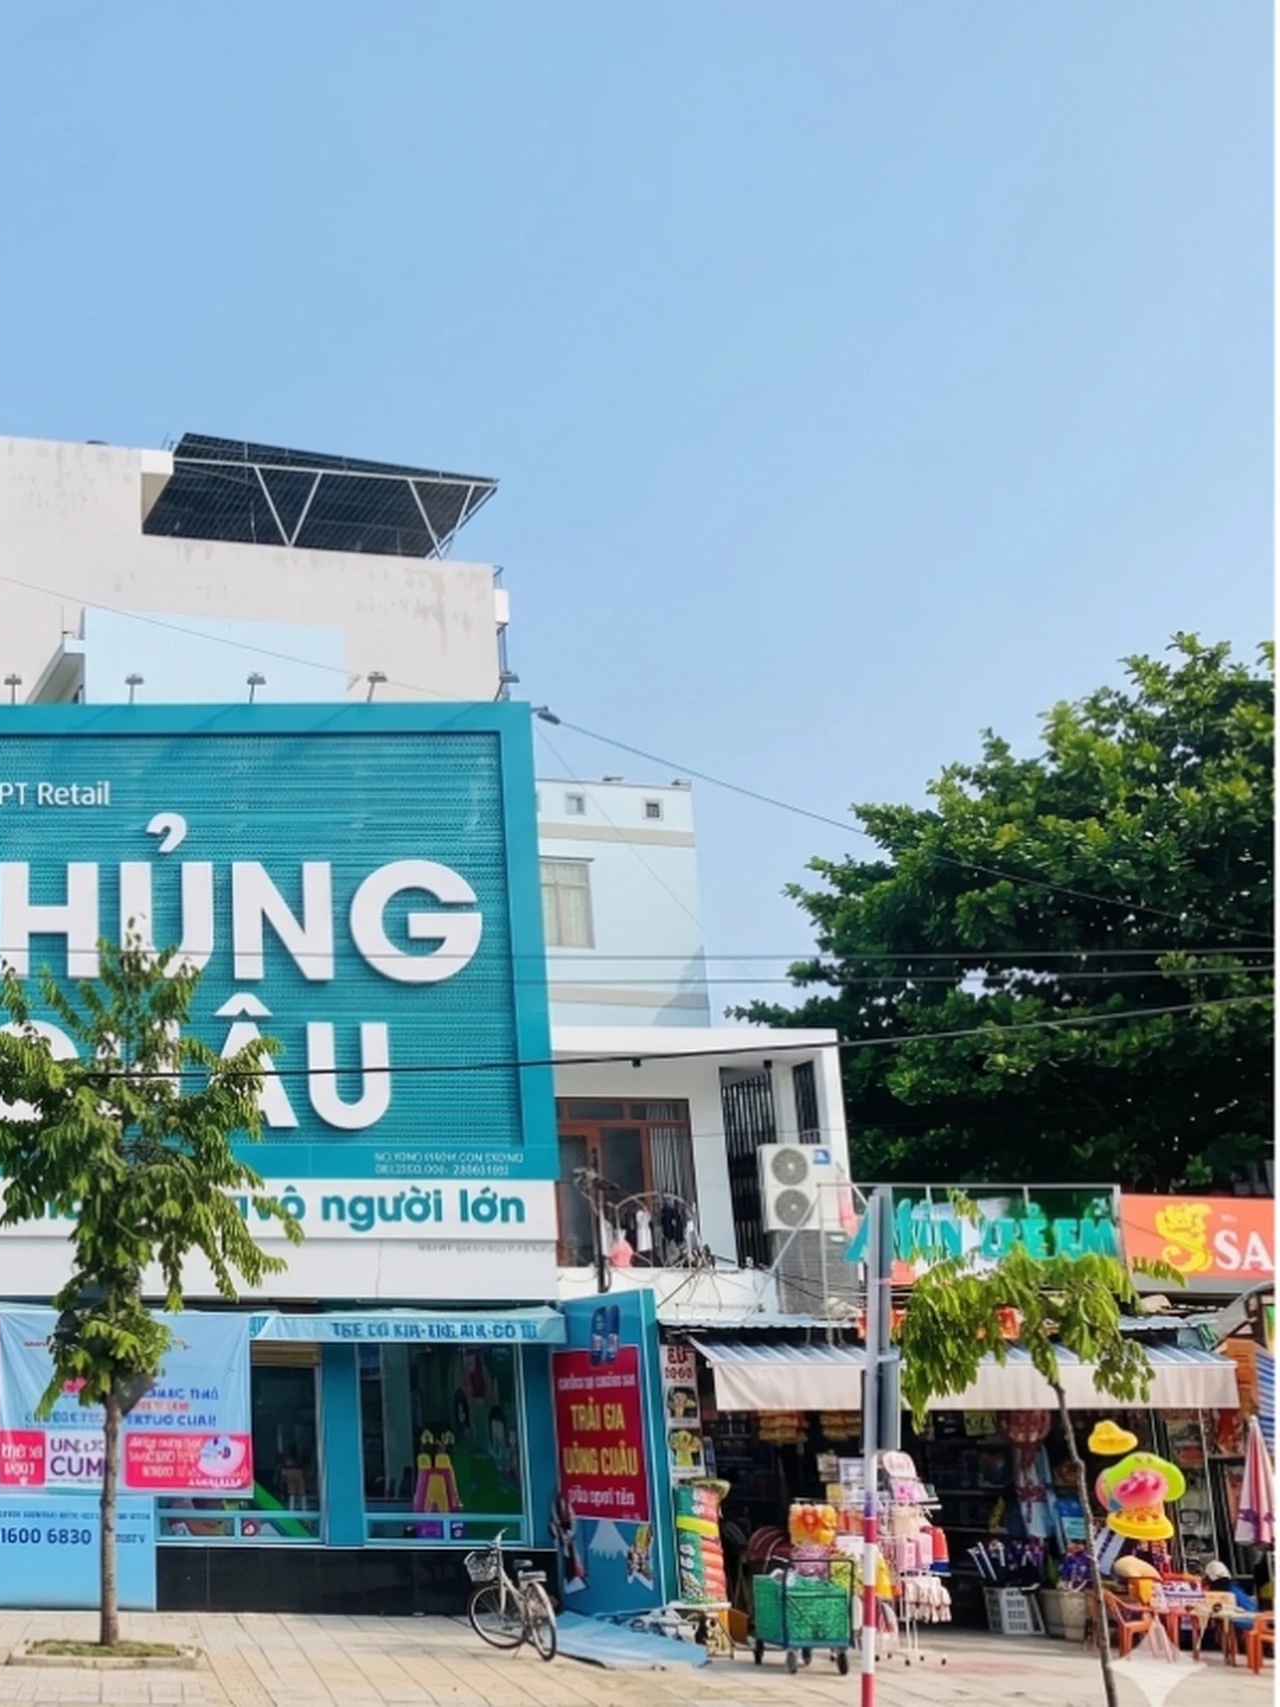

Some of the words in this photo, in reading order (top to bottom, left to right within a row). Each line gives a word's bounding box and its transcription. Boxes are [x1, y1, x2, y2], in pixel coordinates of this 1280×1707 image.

[37, 780, 111, 806] Retail
[321, 1184, 443, 1232] người
[459, 1185, 526, 1223] lớn
[1, 1527, 41, 1544] 1600
[46, 1528, 92, 1545] 6830
